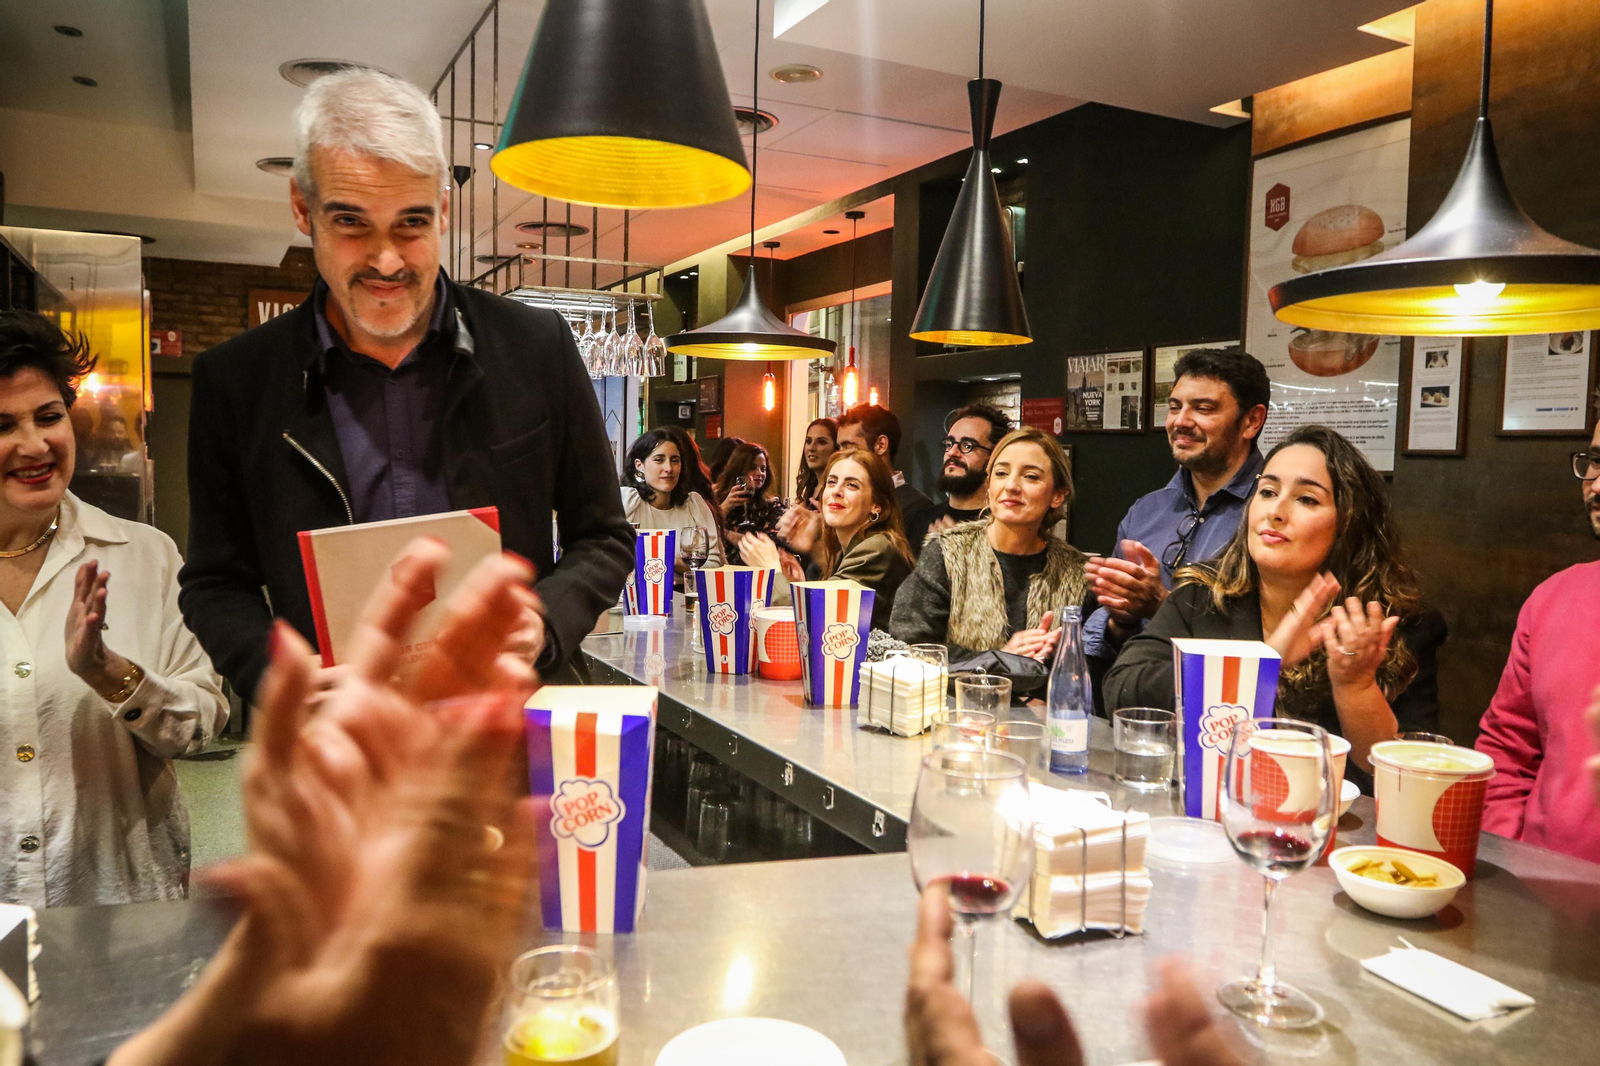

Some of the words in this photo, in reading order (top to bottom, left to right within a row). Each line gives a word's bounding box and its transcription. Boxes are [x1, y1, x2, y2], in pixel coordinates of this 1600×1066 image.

[1067, 356, 1105, 374] VIAJAR
[1082, 391, 1103, 399] NUEVA
[647, 562, 659, 573] POP
[648, 566, 663, 578] CORN
[712, 608, 726, 621] POP
[714, 612, 733, 629] CORN
[828, 635, 854, 651] CORN
[829, 630, 848, 643] POP
[1210, 714, 1238, 732] POP
[563, 792, 598, 815] POP
[563, 802, 612, 832] CORN
